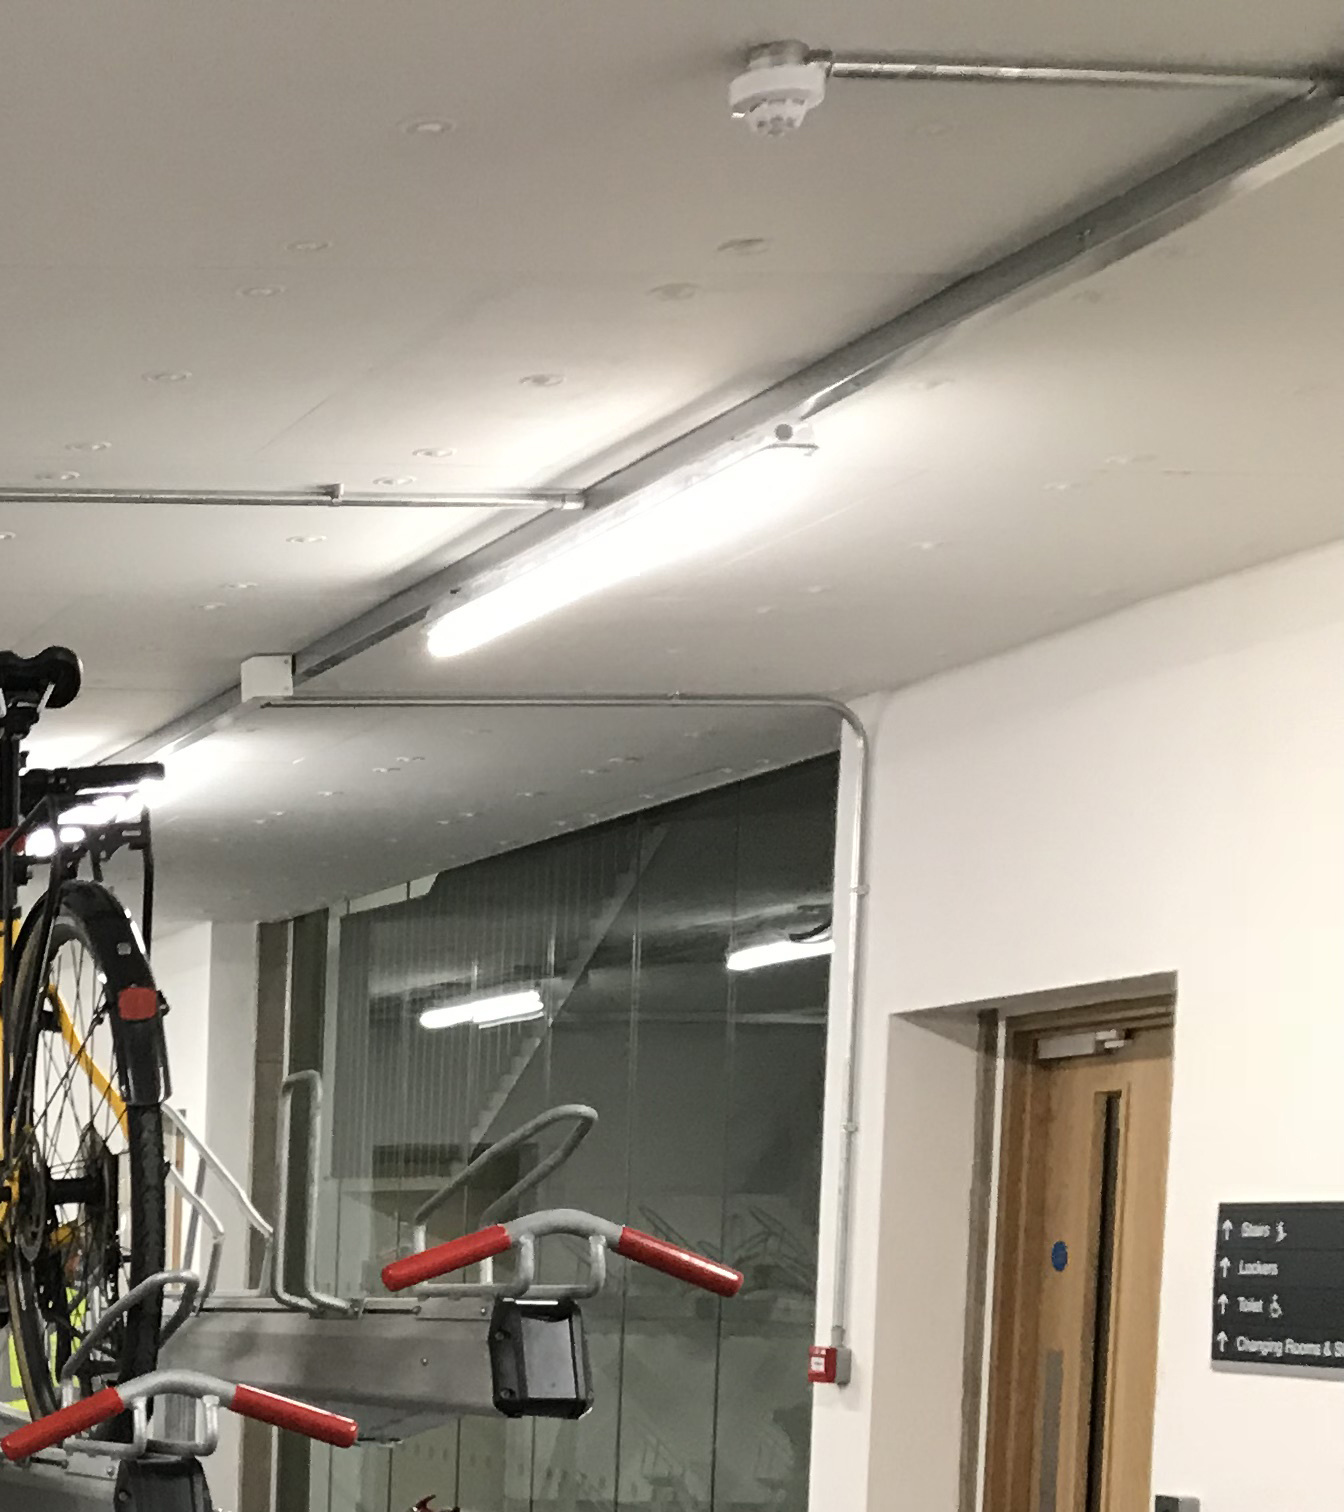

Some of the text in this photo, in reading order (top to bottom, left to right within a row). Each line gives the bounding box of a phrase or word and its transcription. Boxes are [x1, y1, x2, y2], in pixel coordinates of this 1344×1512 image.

[1241, 1221, 1271, 1238] Stairs
[1238, 1259, 1279, 1276] Lockers
[1236, 1335, 1283, 1357] Changing
[1285, 1338, 1321, 1356] Rooms
[1323, 1340, 1332, 1357] &
